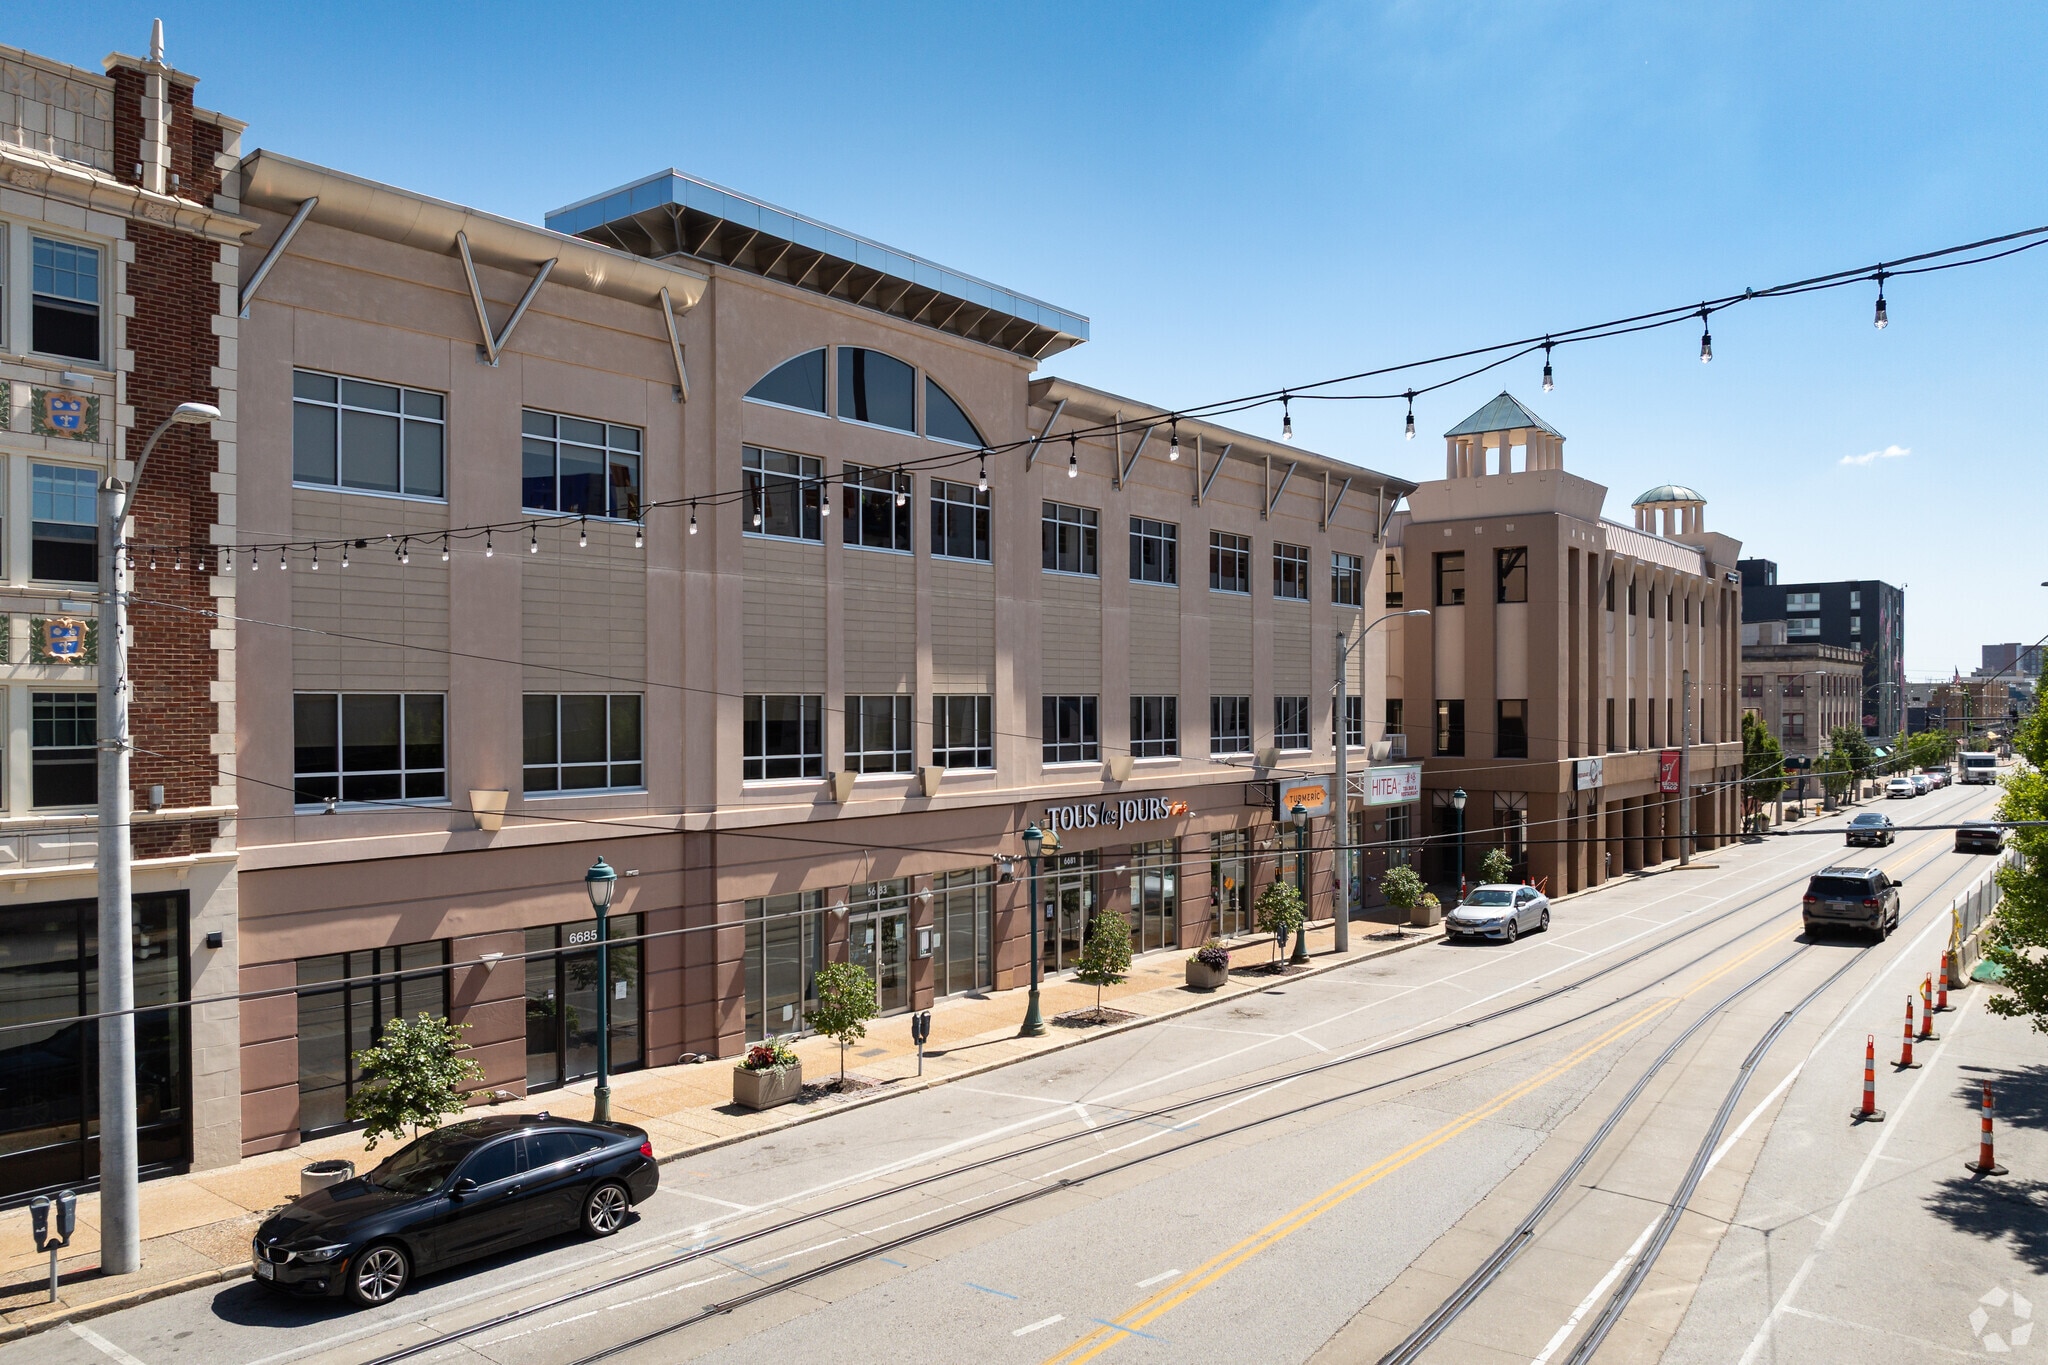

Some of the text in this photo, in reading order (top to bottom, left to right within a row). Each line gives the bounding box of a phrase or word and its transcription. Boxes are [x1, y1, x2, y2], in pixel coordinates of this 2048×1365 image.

[1372, 777, 1398, 796] HITEA
[1289, 790, 1321, 803] TURMERIC
[1046, 803, 1098, 832] TOUS
[1101, 802, 1118, 826] les
[1117, 796, 1169, 830] JOURS
[1063, 856, 1076, 865] 6681
[569, 929, 598, 944] 6685
